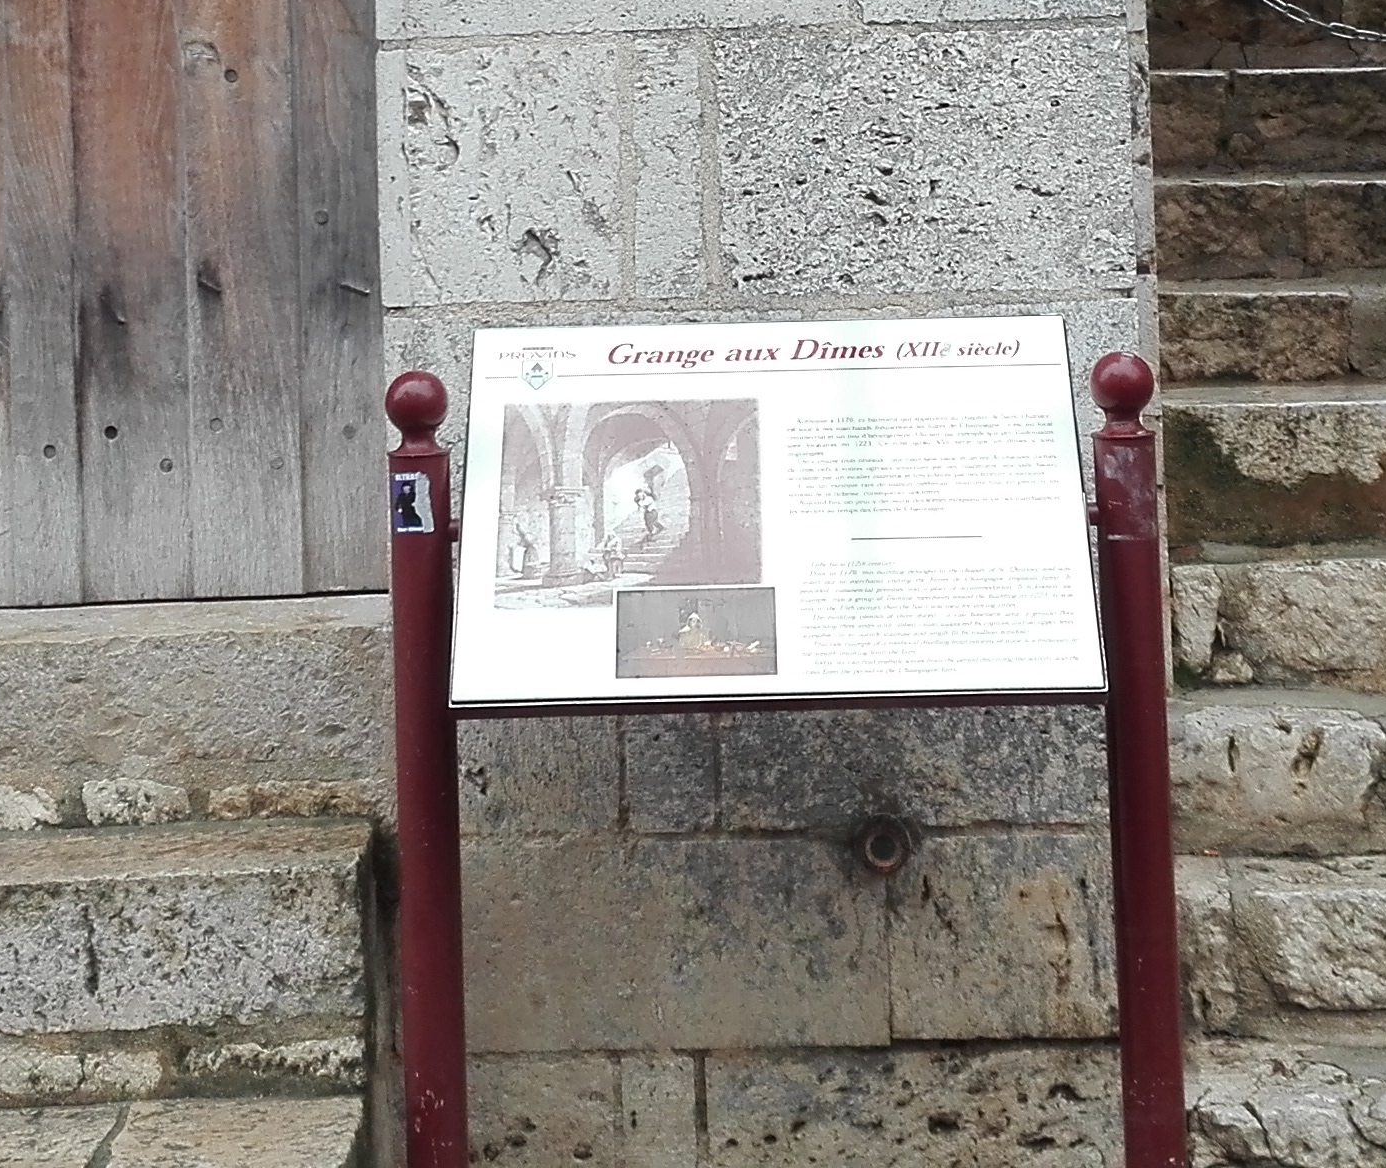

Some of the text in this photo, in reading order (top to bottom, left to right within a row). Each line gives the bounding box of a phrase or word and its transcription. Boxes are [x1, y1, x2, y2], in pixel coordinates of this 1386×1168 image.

[608, 343, 714, 368] Grange
[725, 347, 781, 362] aux
[790, 339, 885, 360] Dîmes
[957, 339, 1020, 358] siècle)
